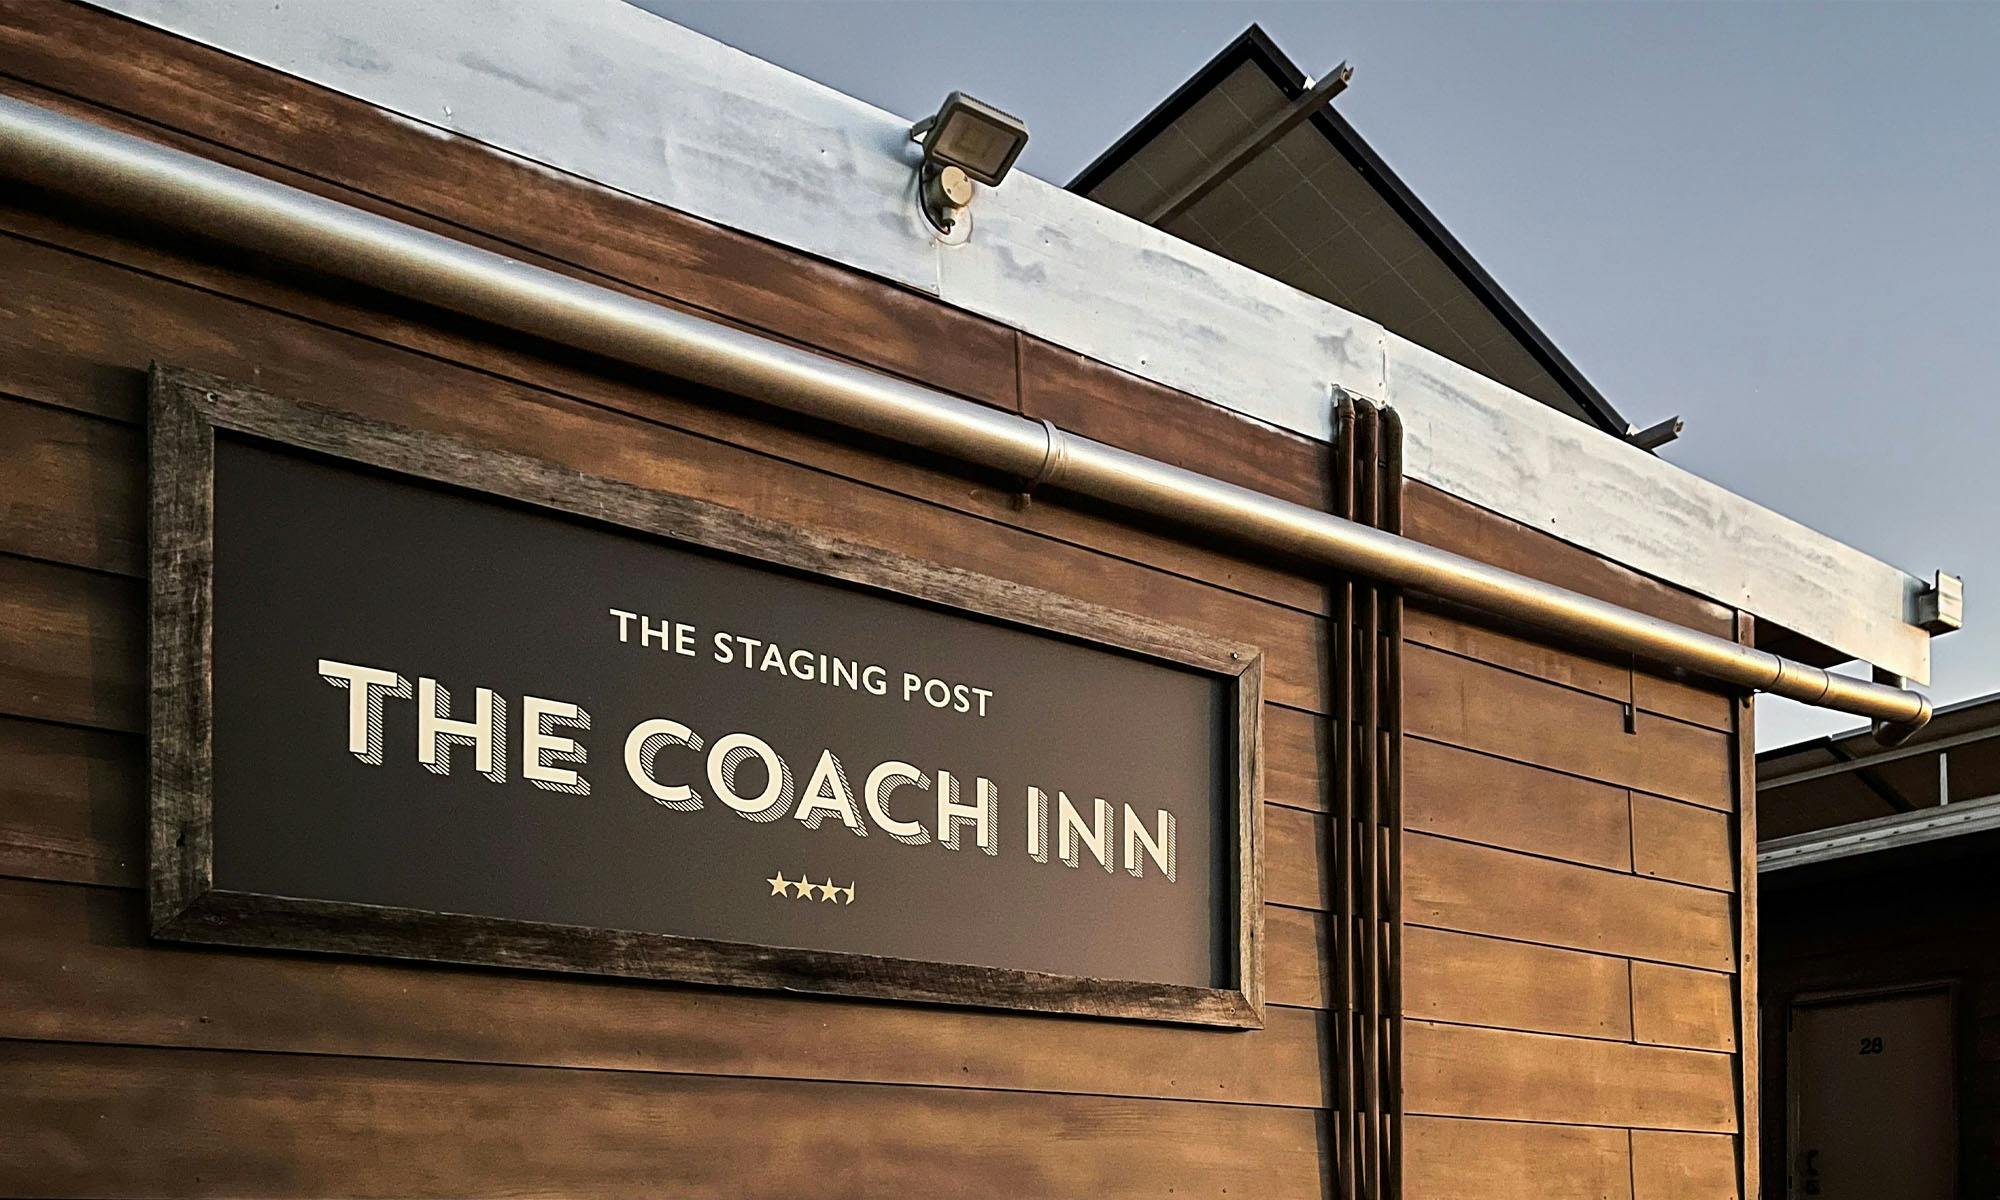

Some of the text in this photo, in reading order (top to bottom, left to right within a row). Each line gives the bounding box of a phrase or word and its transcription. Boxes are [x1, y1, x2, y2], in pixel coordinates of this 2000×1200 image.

[609, 608, 993, 717] THE STAGING POST
[318, 659, 1177, 884] THE COACH INN
